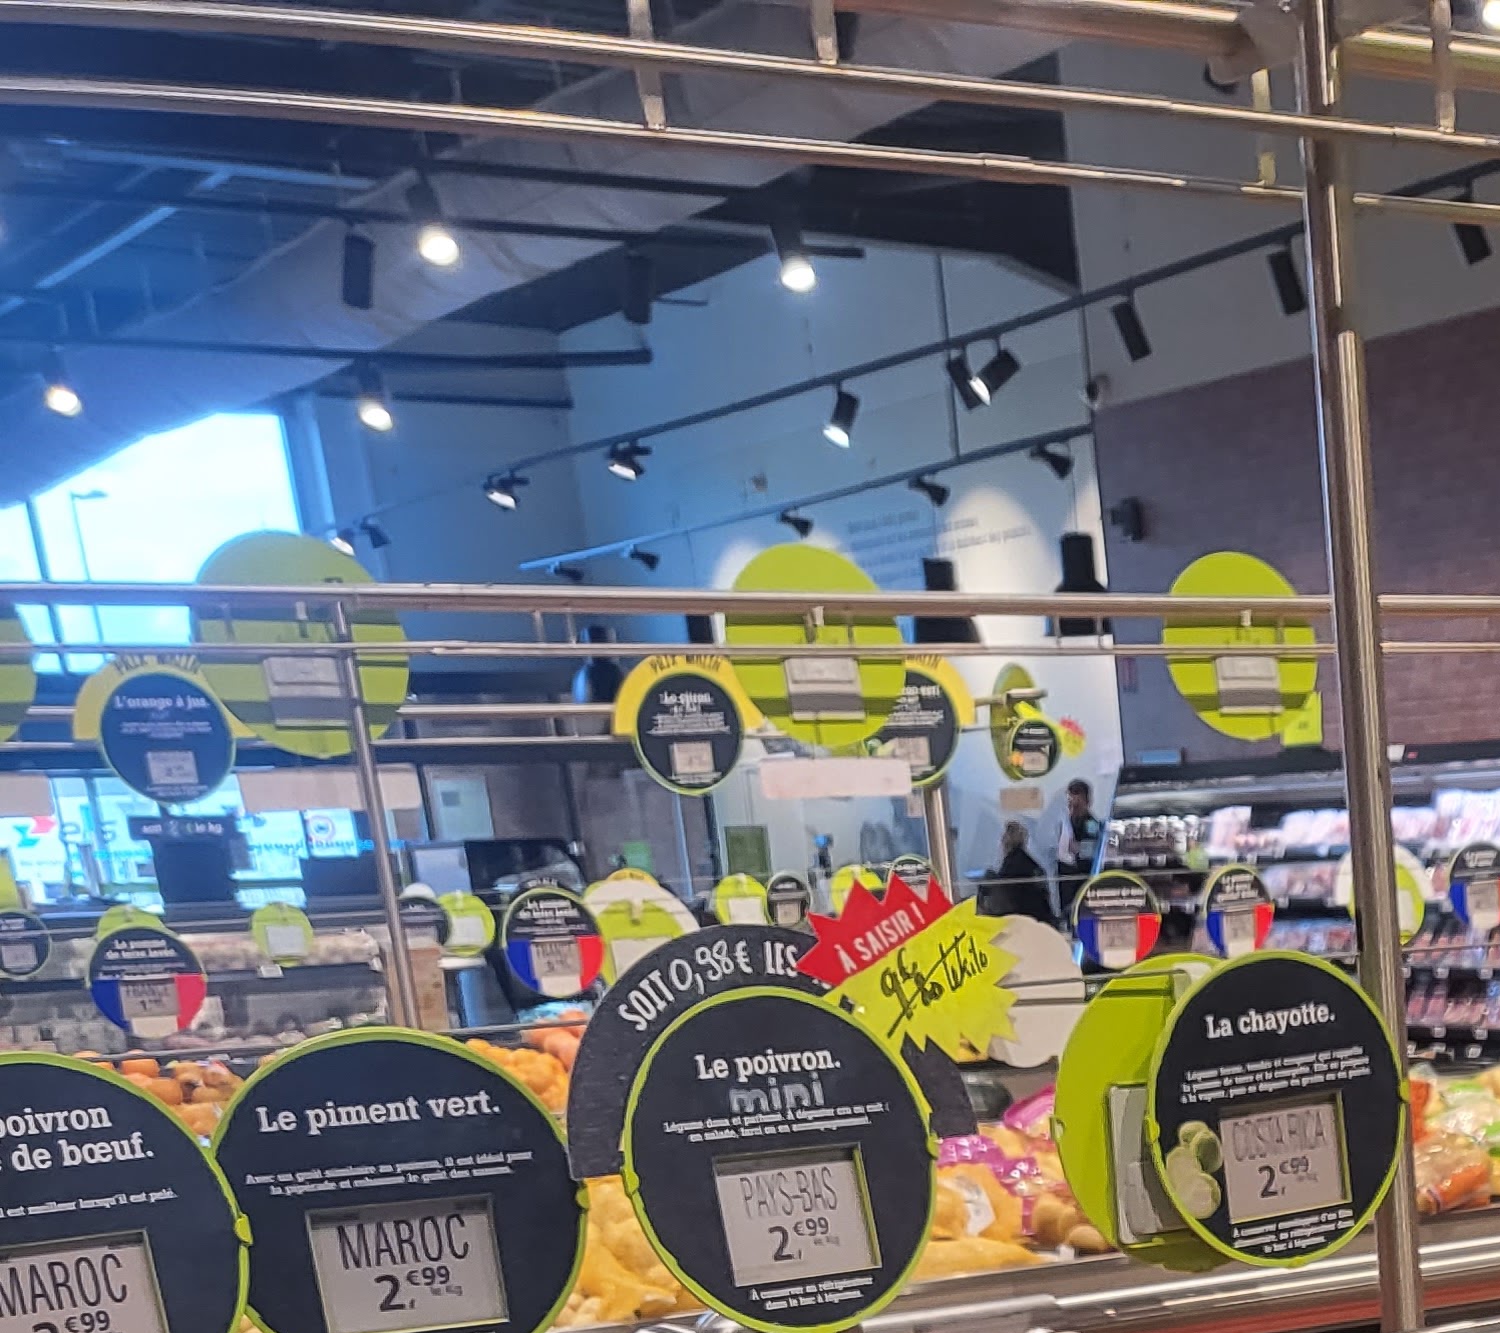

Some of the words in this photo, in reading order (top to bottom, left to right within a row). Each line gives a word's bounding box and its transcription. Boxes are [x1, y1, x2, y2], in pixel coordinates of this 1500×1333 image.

[834, 943, 857, 974] À
[853, 908, 917, 961] SAISIR
[618, 969, 675, 1031] SOIT
[763, 940, 799, 977] LES
[1204, 1014, 1234, 1039] La
[1238, 1000, 1336, 1035] chayotte.
[695, 1053, 730, 1080] Le
[734, 1048, 841, 1083] poivron.
[256, 1106, 298, 1133] Le
[305, 1095, 422, 1136] piment
[426, 1089, 501, 1119] vert.
[729, 1070, 825, 1113] mini
[11, 1143, 52, 1171] de
[58, 1131, 154, 1166] bœuf.
[740, 1166, 838, 1218] PAYS-BAS
[337, 1213, 469, 1270] MAROC
[0, 1253, 128, 1318] MAROC
